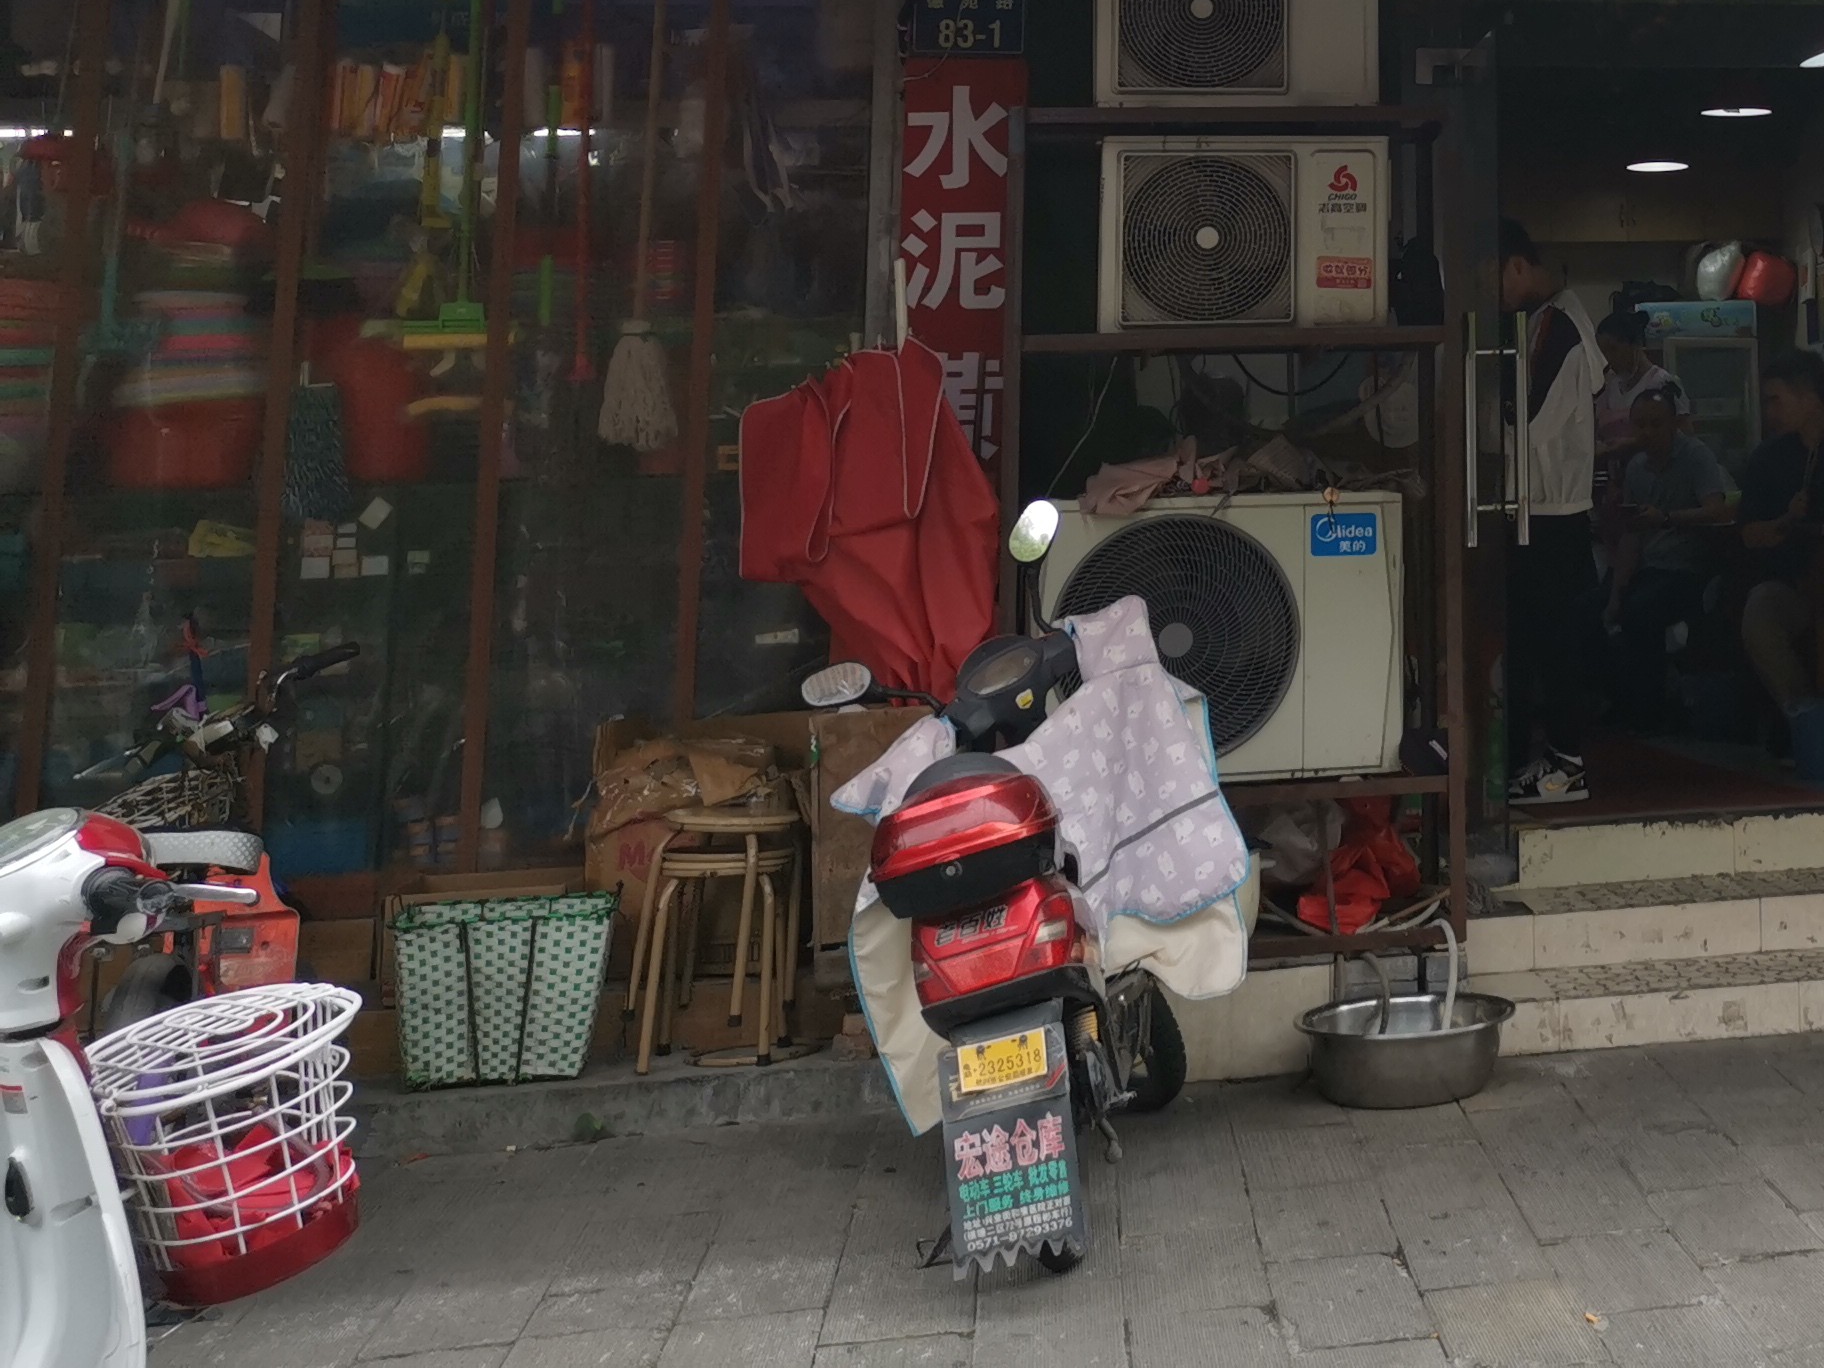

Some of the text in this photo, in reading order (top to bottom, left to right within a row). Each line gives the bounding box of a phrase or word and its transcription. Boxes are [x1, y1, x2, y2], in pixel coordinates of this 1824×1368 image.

[938, 18, 1001, 49] 83-1
[1327, 192, 1358, 201] CHIGO
[1339, 540, 1367, 553] 美的
[978, 1047, 1042, 1077] 2325318
